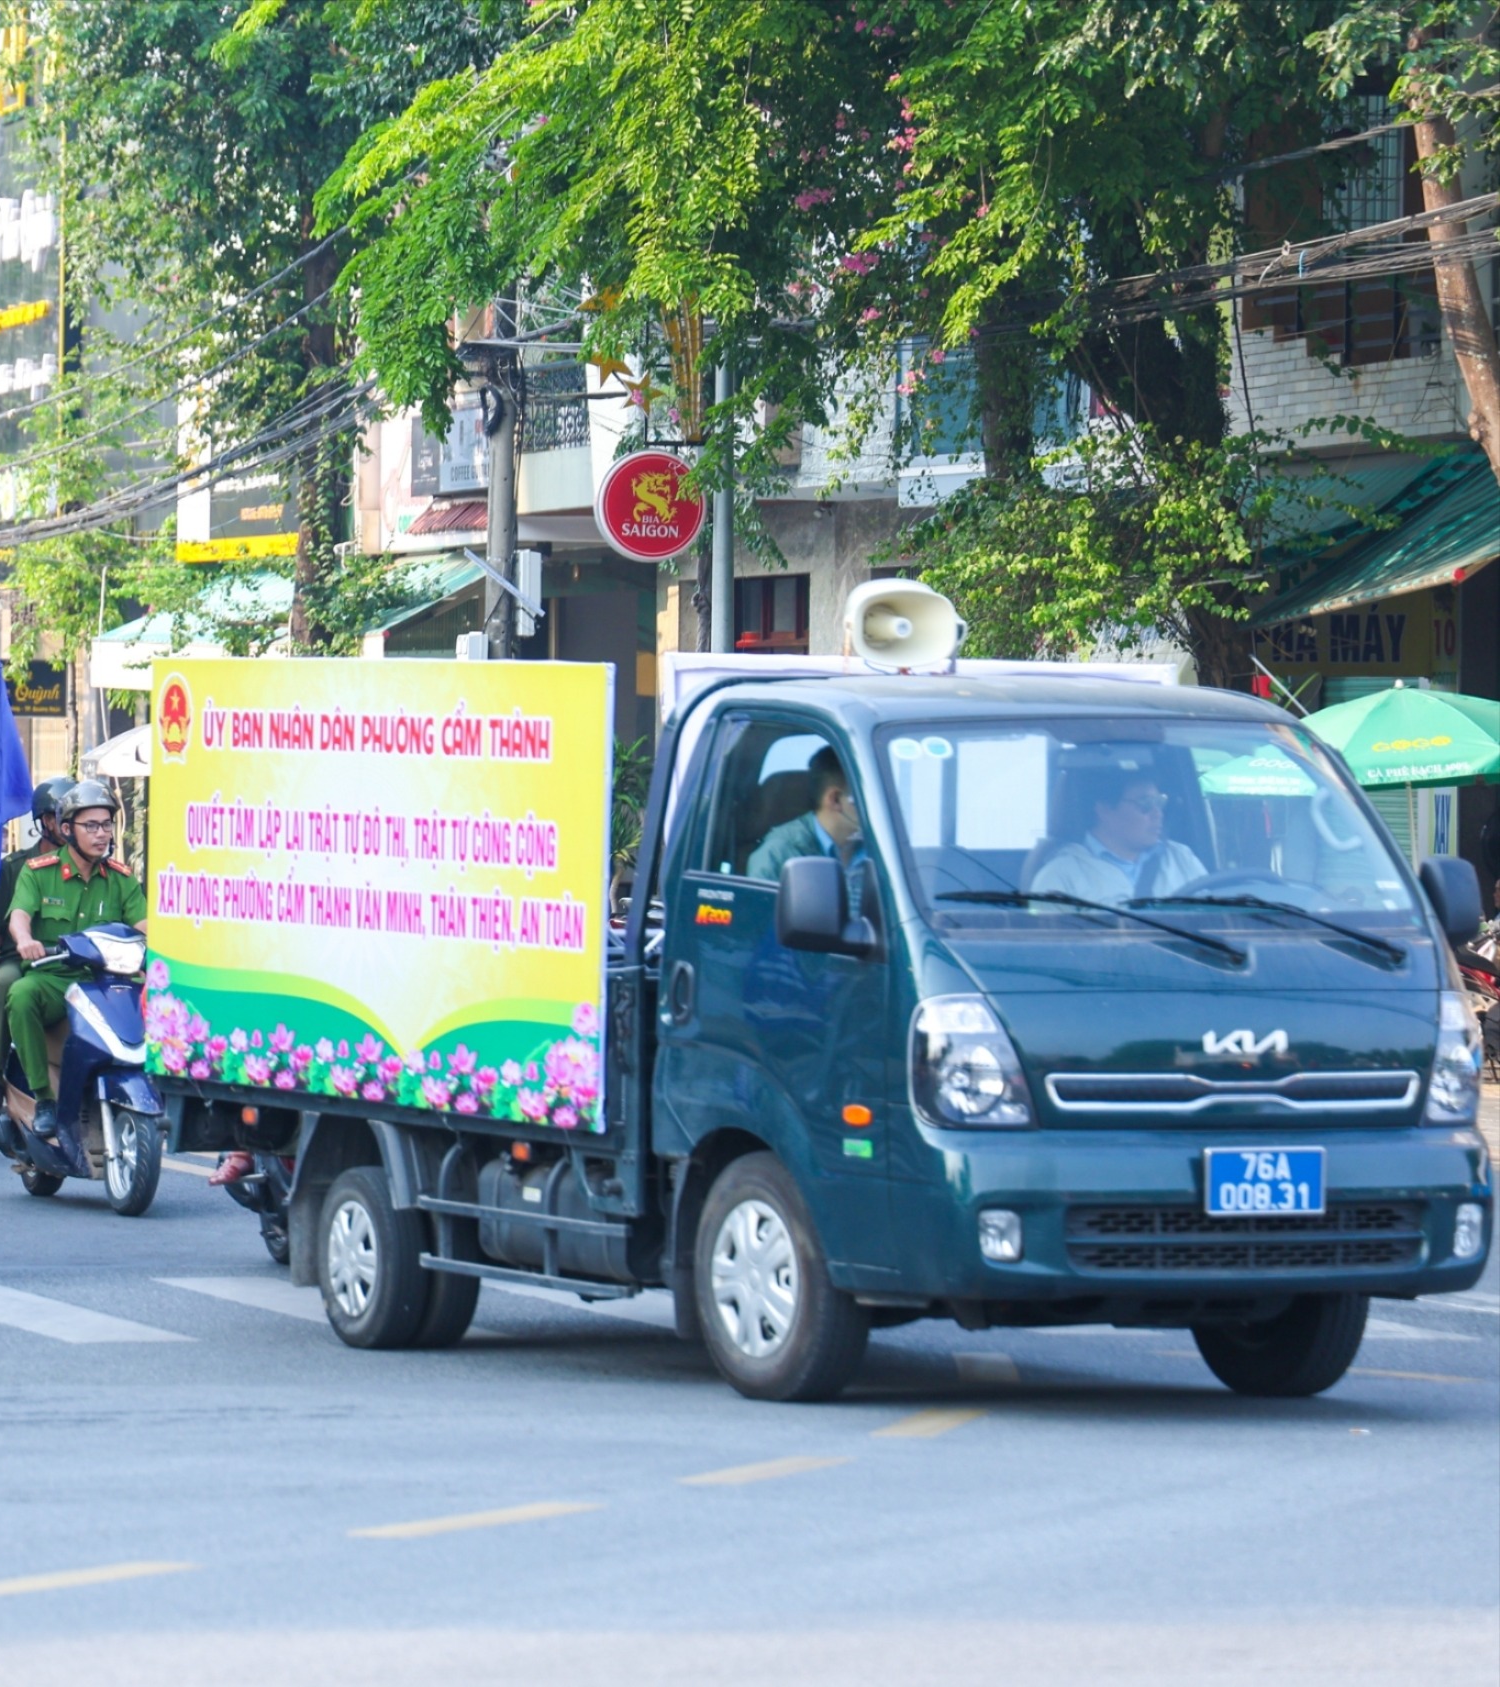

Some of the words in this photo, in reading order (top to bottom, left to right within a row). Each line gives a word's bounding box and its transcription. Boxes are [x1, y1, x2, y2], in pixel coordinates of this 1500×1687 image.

[621, 522, 679, 539] SAIGON
[642, 515, 659, 524] BIA
[1330, 603, 1406, 663] MÁY
[203, 699, 227, 747] ỦY
[232, 712, 264, 749] BAN
[269, 704, 314, 751] NHÂN
[320, 705, 355, 752] DÂN
[362, 707, 435, 755] PHƯỜNG
[441, 701, 482, 757] CẨM
[489, 709, 552, 759] THÀNH
[188, 793, 225, 849] QUYẾT
[229, 798, 254, 848] TÂM
[259, 799, 281, 858] LẬP
[286, 810, 304, 860] LẠI
[309, 803, 339, 863] TRẬT
[344, 810, 361, 864] TỰ
[364, 806, 380, 856] ĐÔ
[385, 816, 409, 868] THỊ,
[414, 809, 446, 870] TRẬT
[452, 816, 470, 872] TỰ
[473, 811, 511, 864] CÔNG
[516, 813, 556, 877] CỘNG
[159, 866, 183, 914] XÂY
[186, 872, 219, 926] DỰNG
[223, 869, 273, 921] PHƯỜNG
[277, 865, 305, 924] CẨM
[310, 876, 352, 929] THÀNH
[356, 882, 382, 931] VĂN
[386, 890, 426, 940] MINH,
[430, 886, 467, 938] THÂN
[471, 888, 515, 952] THIỆN,
[520, 900, 540, 944] AN
[545, 893, 584, 949] TOÀN
[1202, 1029, 1289, 1055] KIA
[1240, 1152, 1292, 1181] 76A
[1219, 1182, 1310, 1211] 008.31
